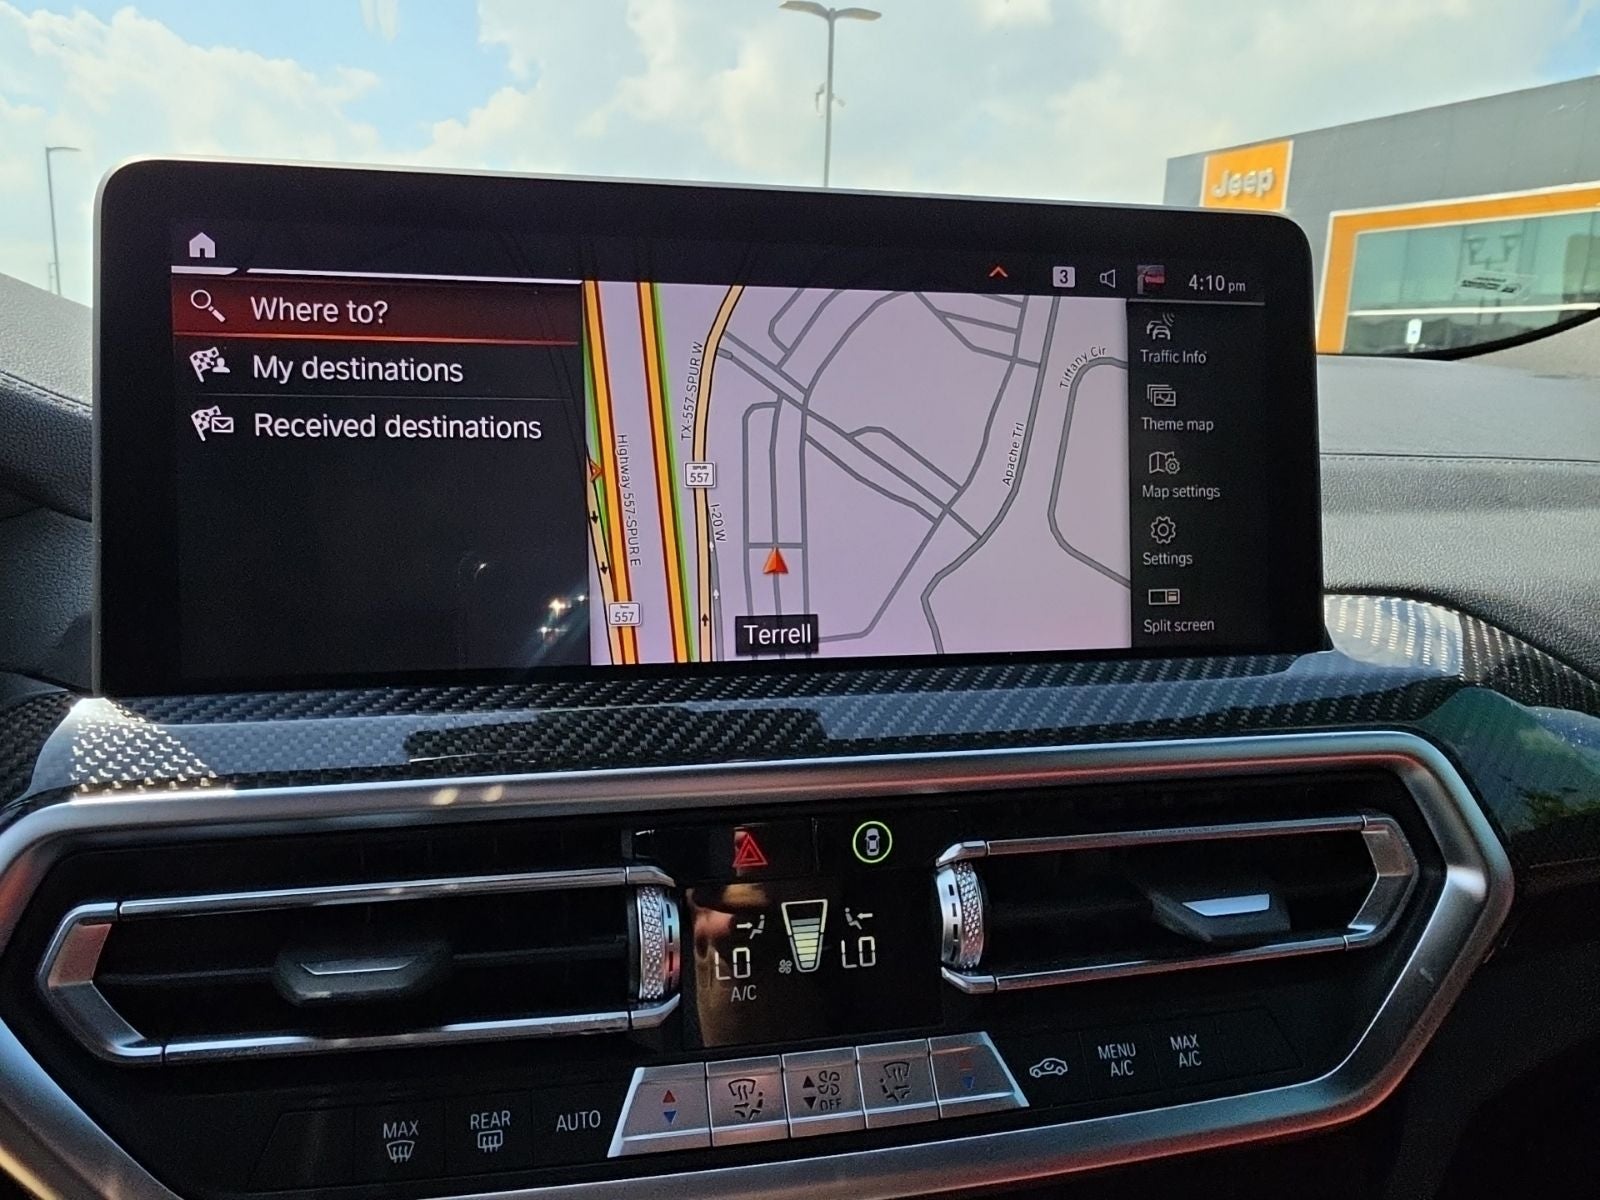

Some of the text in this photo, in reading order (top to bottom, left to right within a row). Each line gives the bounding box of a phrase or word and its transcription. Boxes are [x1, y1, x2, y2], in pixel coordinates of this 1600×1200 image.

[1211, 167, 1273, 198] Jeep
[1060, 270, 1068, 284] 3
[1188, 274, 1246, 293] 4:10 pm
[250, 295, 389, 324] Where to?
[1140, 350, 1206, 364] Traffic Info
[253, 355, 464, 384] My destinations
[1059, 346, 1106, 389] Tiffany Cir
[681, 341, 704, 441] TX-557-SPUR W
[254, 412, 542, 440] Received destinations
[1141, 417, 1214, 432] Theme map
[1002, 422, 1025, 487] Apache Trl
[690, 472, 709, 483] 557
[616, 434, 630, 491] Highway
[623, 492, 641, 554] 557-SPUR
[1142, 485, 1220, 500] Map settings
[710, 503, 727, 543] I-20 W
[1143, 552, 1193, 567] Settings
[615, 612, 634, 622] 557
[743, 624, 812, 645] Terrell
[1144, 619, 1215, 634] Split screen
[731, 984, 757, 1002] A/C
[1098, 1042, 1136, 1060] MENU
[1170, 1034, 1199, 1050] MAX
[1179, 1050, 1202, 1068] A/C
[1111, 1060, 1134, 1077] A/C
[820, 1098, 841, 1111] OFF
[383, 1119, 419, 1139] MAX
[470, 1110, 511, 1130] REAR
[556, 1109, 601, 1132] AUTO
